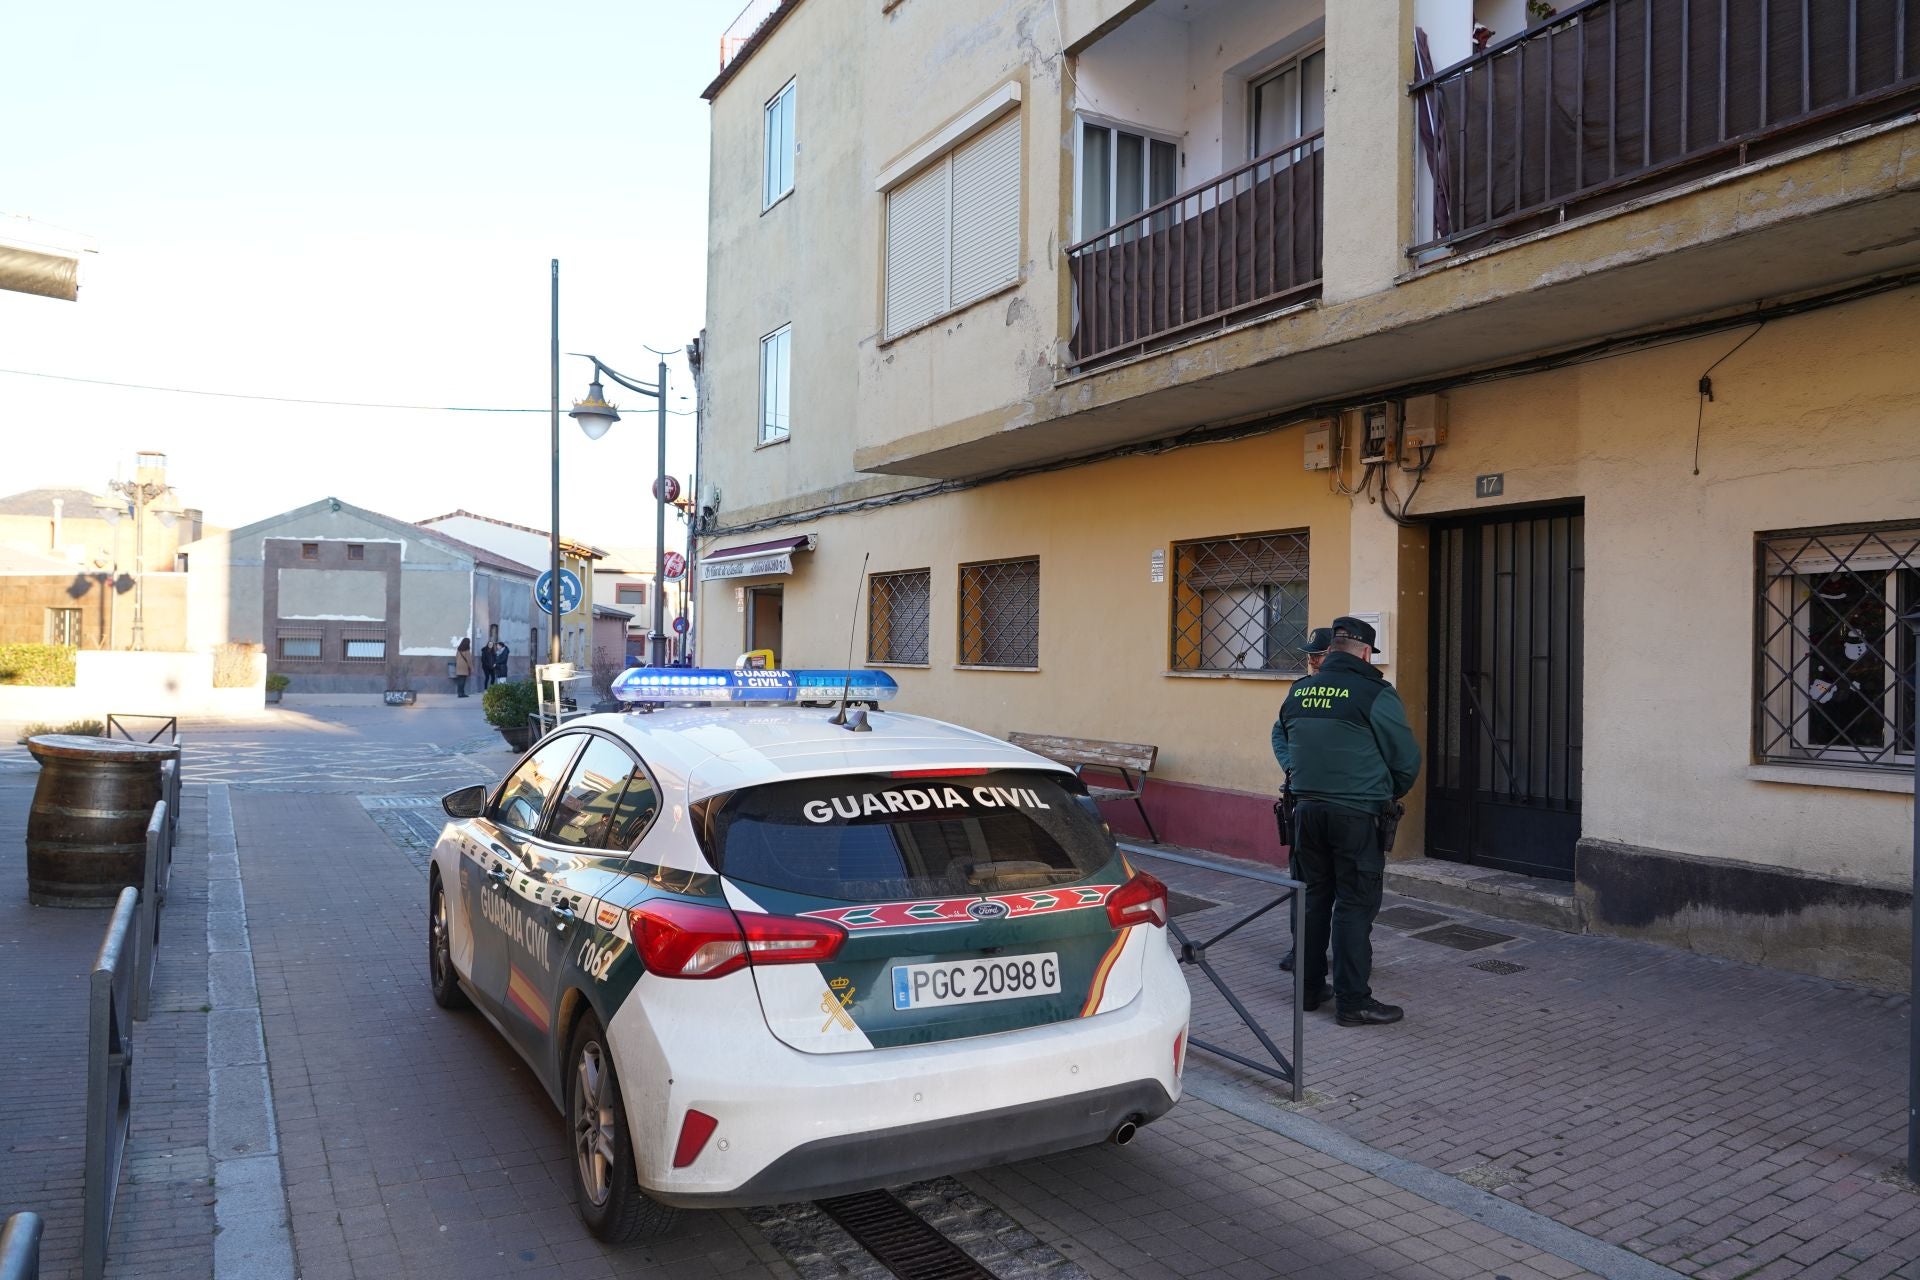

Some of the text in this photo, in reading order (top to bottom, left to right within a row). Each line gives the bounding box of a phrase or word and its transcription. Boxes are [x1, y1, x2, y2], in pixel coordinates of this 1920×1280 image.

[1481, 476, 1498, 494] 17
[733, 670, 790, 678] GUARDIA
[748, 678, 783, 687] CIVIL
[1294, 687, 1349, 698] GUARDIA
[1302, 698, 1331, 708] CIVIL
[803, 786, 1050, 823] GUARDIA CIVIL
[978, 904, 999, 915] Ford
[481, 886, 550, 972] GUARDIA CIVIL
[913, 958, 1056, 1002] PGC 2098 G
[899, 991, 906, 1001] E
